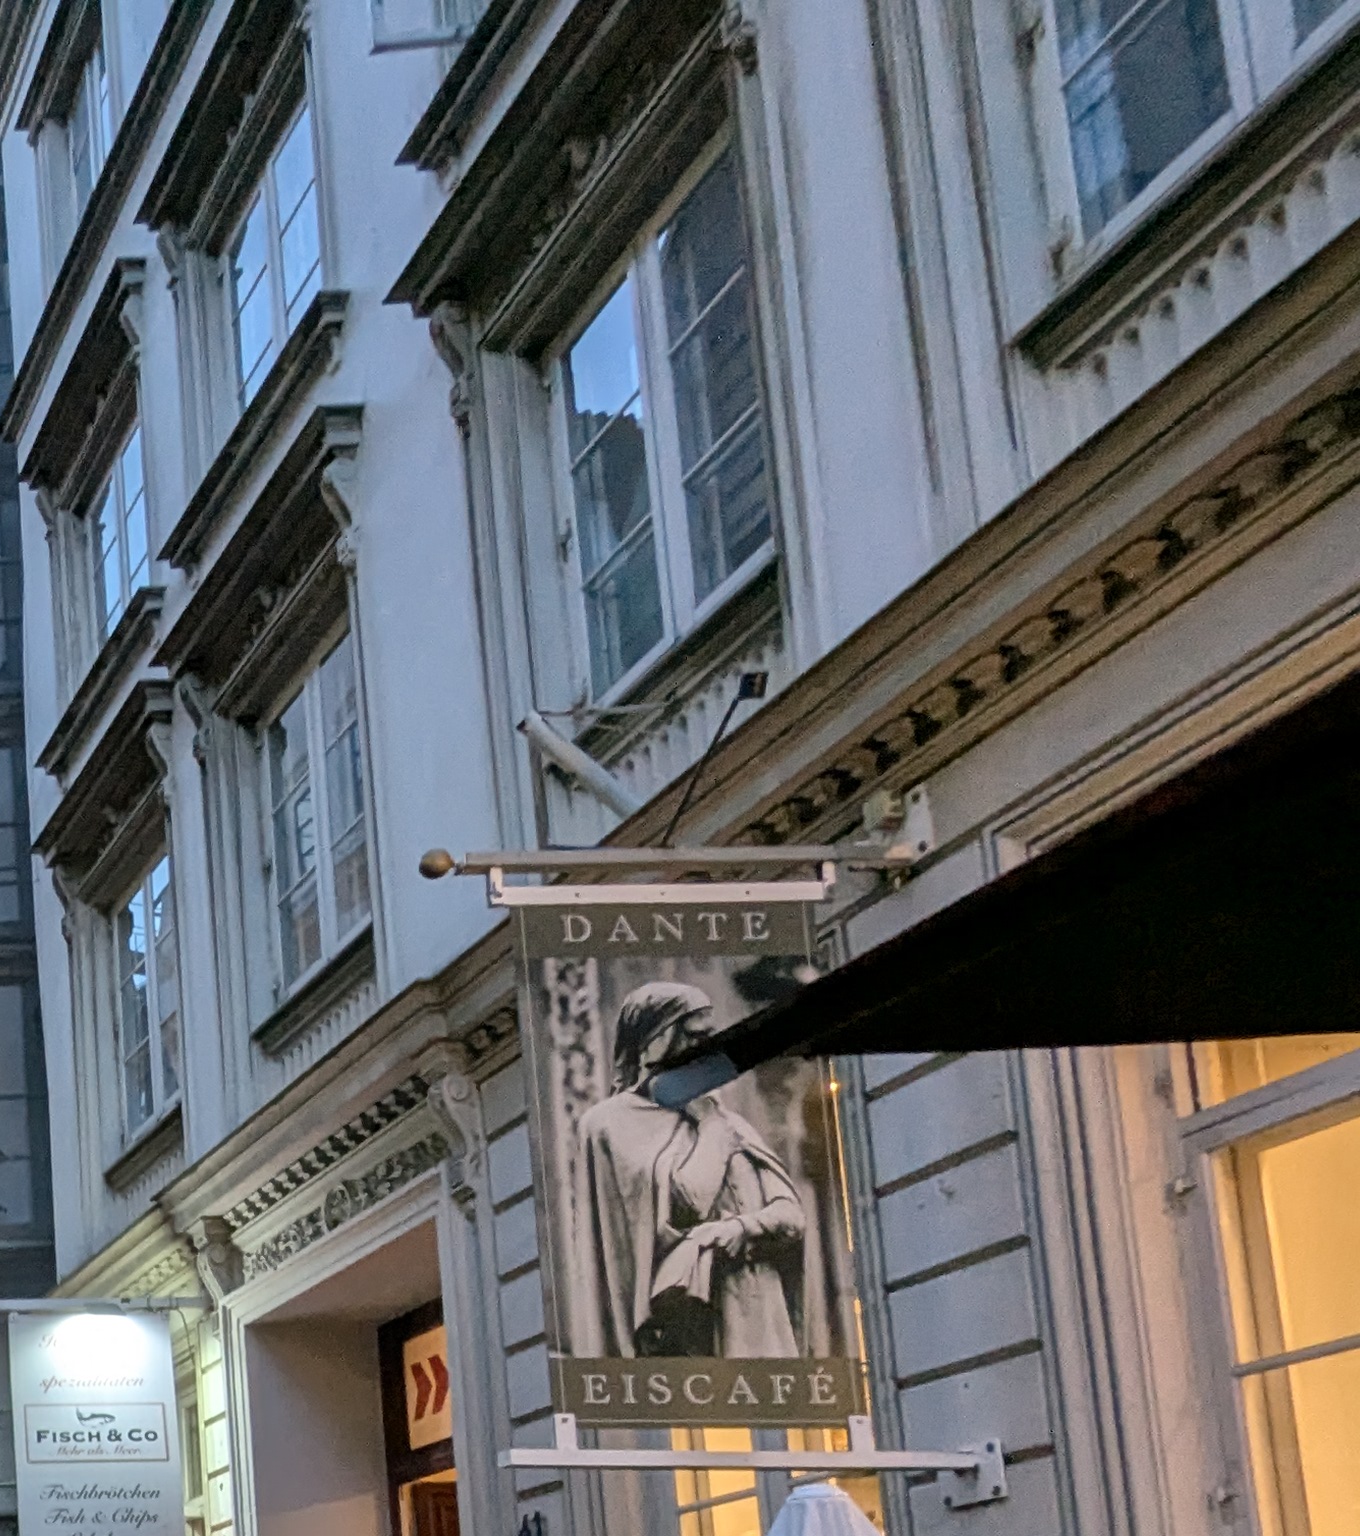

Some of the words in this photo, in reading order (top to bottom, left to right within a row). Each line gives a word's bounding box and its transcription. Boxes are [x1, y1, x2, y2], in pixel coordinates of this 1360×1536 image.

[561, 911, 771, 944] DANTE
[581, 1367, 838, 1406] EISCAFÉ
[107, 1429, 122, 1442] &
[40, 1483, 160, 1500] Fischbrötchen
[44, 1507, 86, 1524] Fish
[92, 1511, 107, 1523] &
[112, 1507, 159, 1528] Chips
